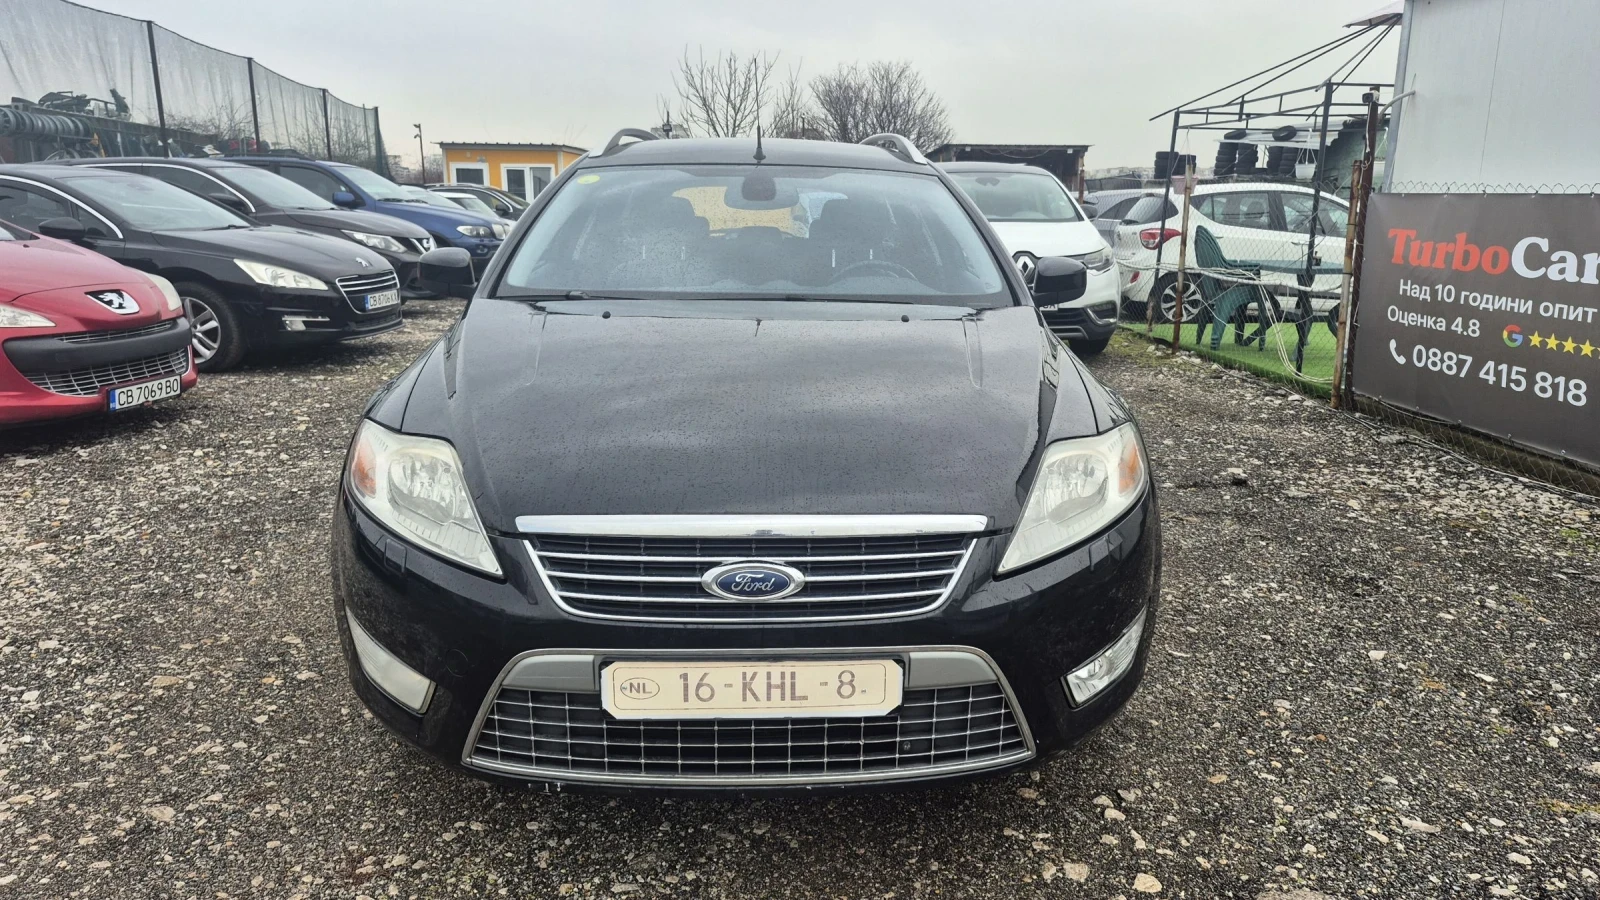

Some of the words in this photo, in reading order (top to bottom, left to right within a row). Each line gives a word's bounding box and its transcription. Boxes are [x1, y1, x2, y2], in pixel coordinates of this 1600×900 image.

[1388, 228, 1600, 284] TurboCar
[1399, 279, 1430, 302] Над
[1435, 284, 1455, 303] 10
[1460, 290, 1533, 315] години
[1539, 301, 1598, 323] опит
[1387, 305, 1446, 332] Оценка
[1451, 317, 1480, 338] 4.8
[1502, 324, 1523, 348] G
[1412, 344, 1473, 378] 0887
[1479, 360, 1527, 392] 415
[1534, 371, 1587, 407] 818
[118, 389, 134, 406] CB
[136, 382, 163, 402] 7069
[731, 573, 776, 592] Ford
[629, 682, 652, 694] NL
